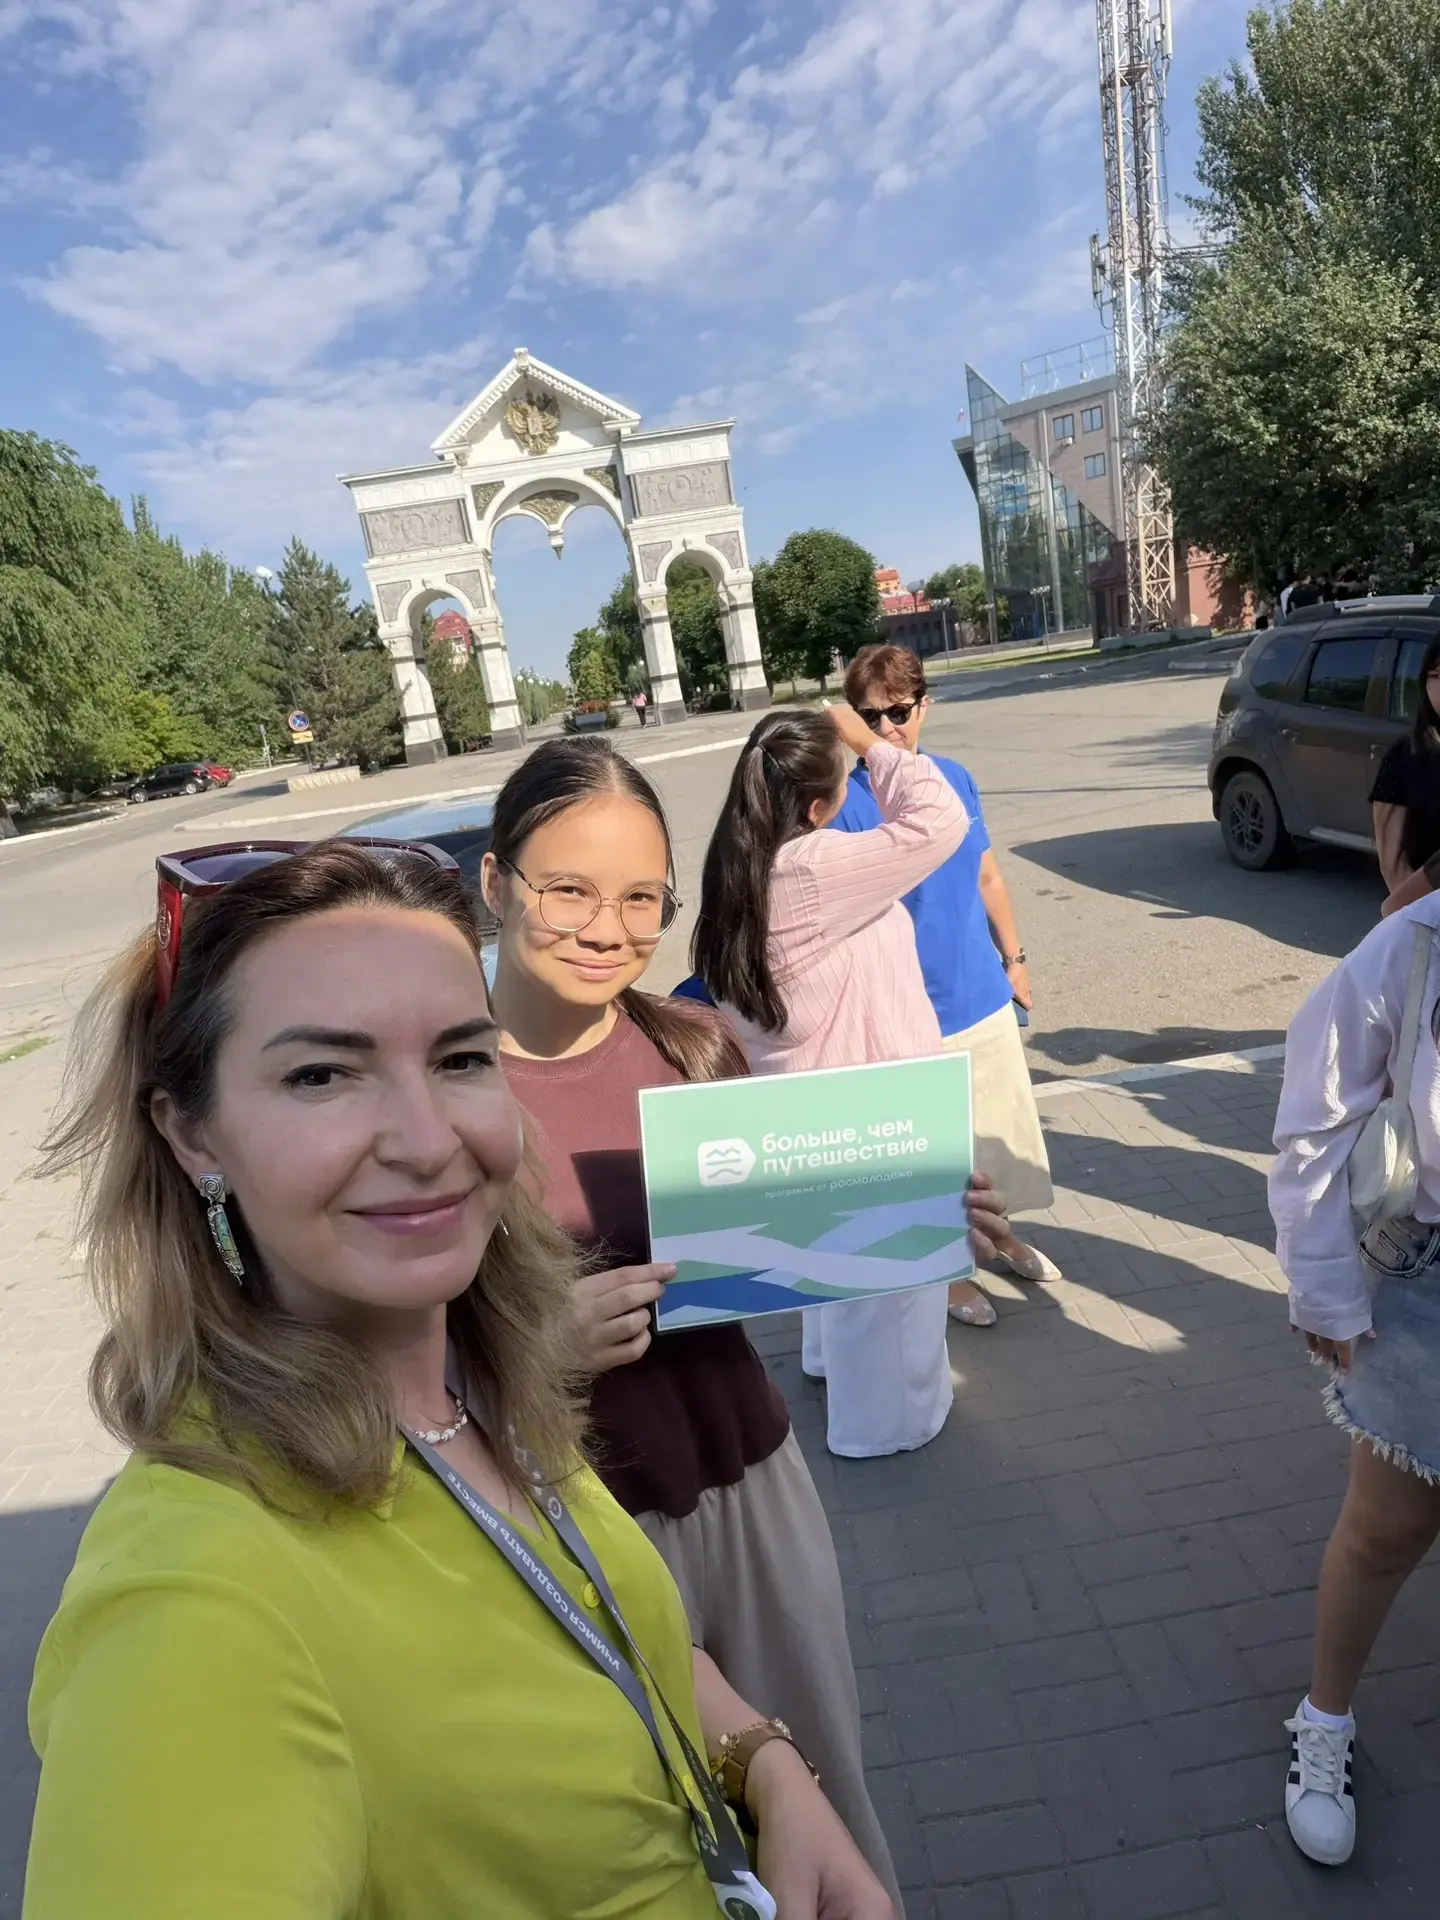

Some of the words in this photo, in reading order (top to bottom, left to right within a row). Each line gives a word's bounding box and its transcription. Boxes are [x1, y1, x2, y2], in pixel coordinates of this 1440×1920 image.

[763, 1128, 862, 1153] больше,
[868, 1119, 913, 1138] чем
[763, 1138, 928, 1176] путешествие
[447, 1471, 498, 1530] ВМЕСТЕ
[500, 1528, 569, 1613] СОЗДАВАТЬ
[570, 1610, 620, 1671] УЧИМСЯ
